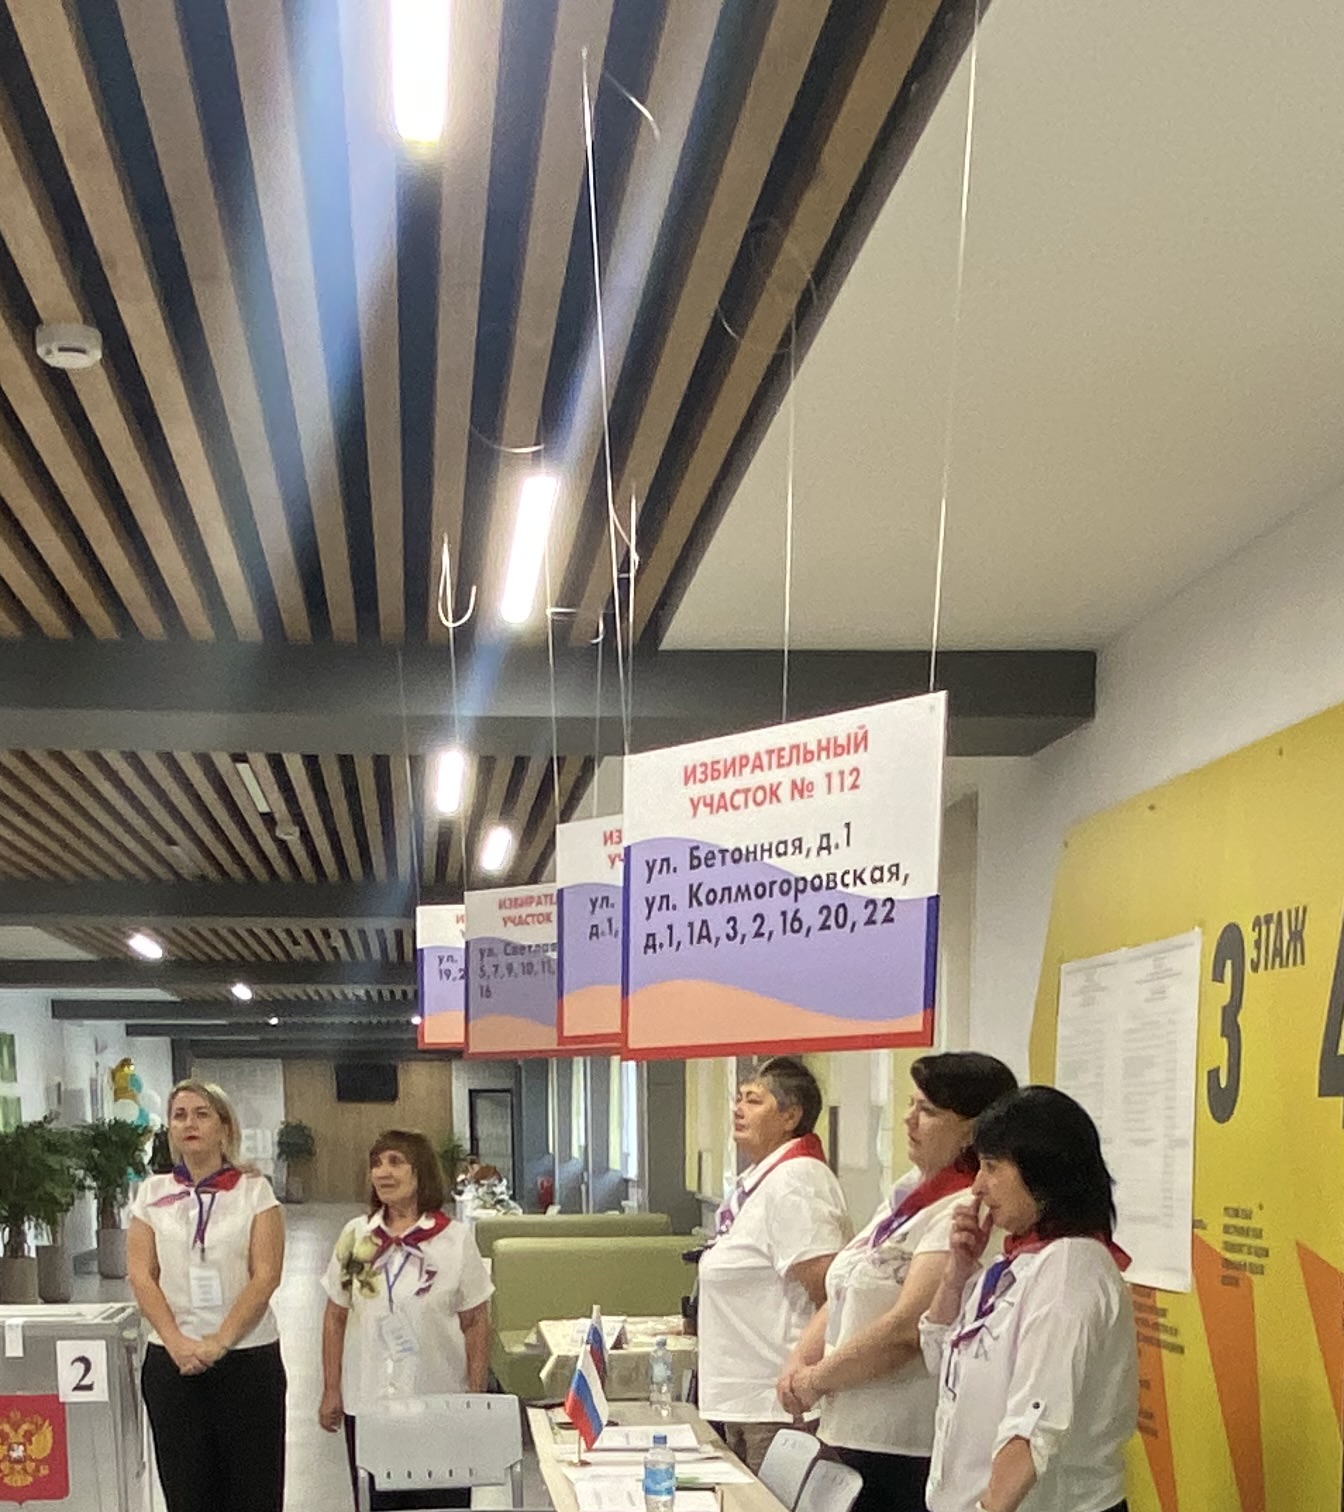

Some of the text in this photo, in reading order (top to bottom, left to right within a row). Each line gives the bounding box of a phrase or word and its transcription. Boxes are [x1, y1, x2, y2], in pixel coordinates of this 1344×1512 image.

[683, 724, 869, 786] ИЗБИРАТЕЛЬНЫЙ
[689, 767, 861, 818] УЧАСТОК № 112
[645, 822, 852, 883] ул. Бетонная, д.1
[644, 862, 910, 921] ул. Колмогоровская,
[780, 908, 812, 938] 16,
[818, 902, 857, 933] 20,
[863, 897, 896, 926] 22
[1207, 905, 1307, 1124] 3 ЭТАЖ
[70, 1355, 95, 1392] 2
